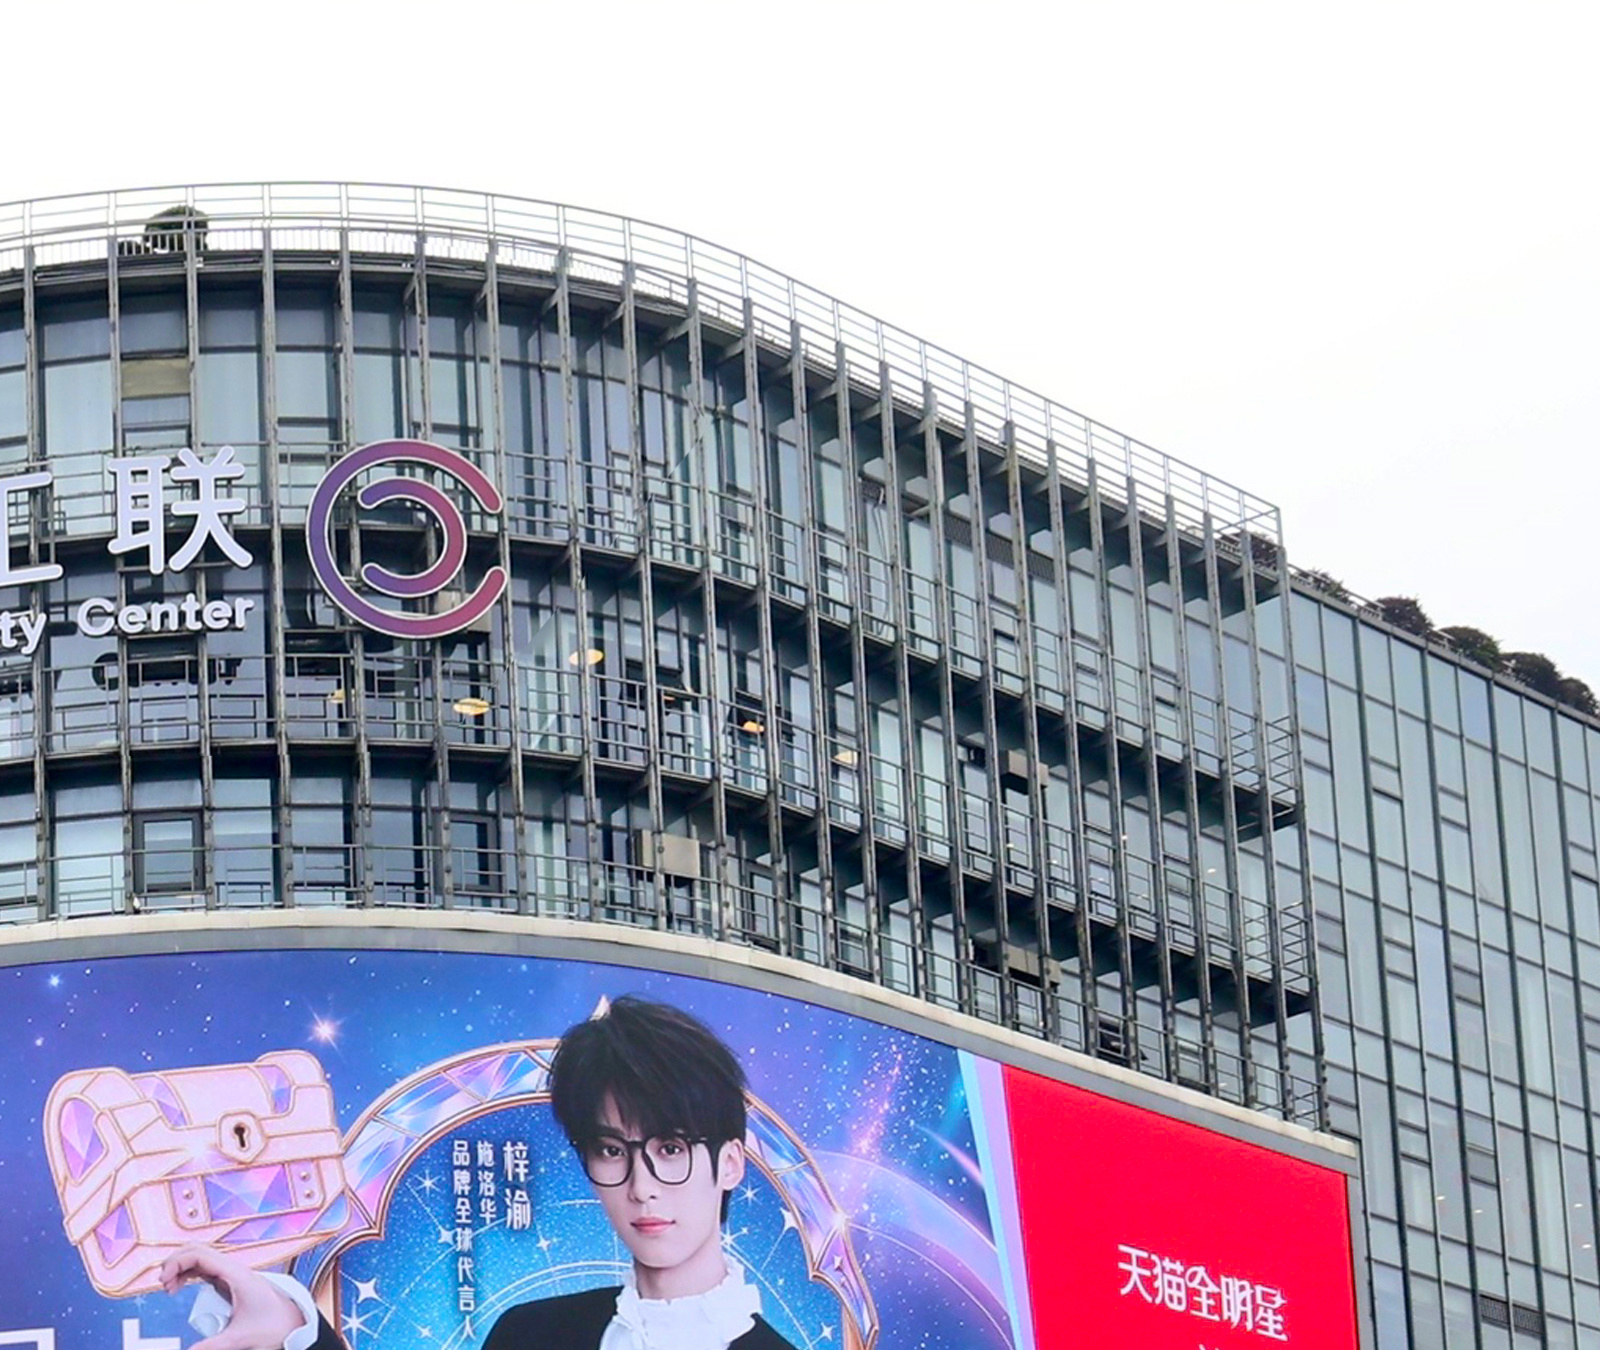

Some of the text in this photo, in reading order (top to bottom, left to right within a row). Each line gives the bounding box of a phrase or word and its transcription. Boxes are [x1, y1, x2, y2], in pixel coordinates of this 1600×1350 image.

[78, 592, 256, 638] Center
[503, 1141, 532, 1230] 梓渝
[453, 1140, 477, 1340] 品牌全球代言人
[1116, 1244, 1288, 1341] 天猫全明星
